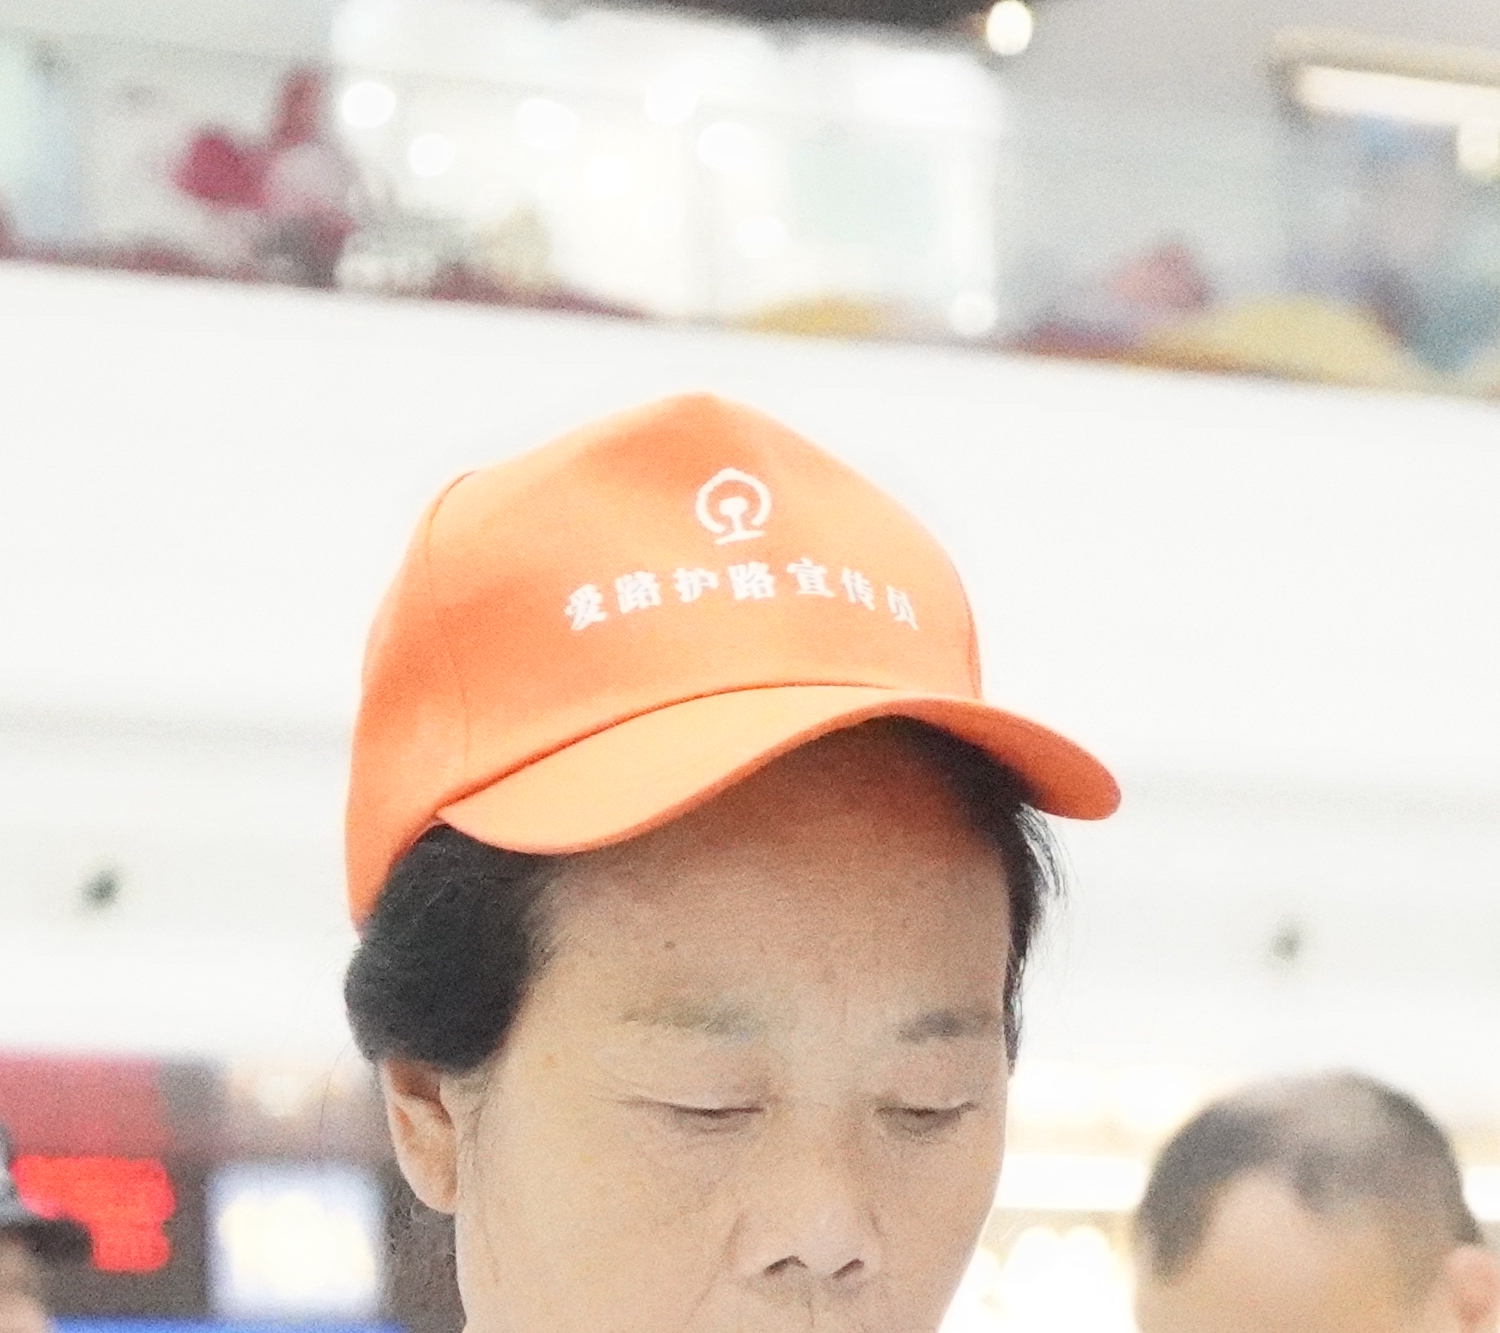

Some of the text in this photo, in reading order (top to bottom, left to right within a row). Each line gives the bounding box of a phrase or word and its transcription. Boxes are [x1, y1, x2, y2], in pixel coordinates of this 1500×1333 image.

[563, 556, 921, 632] 爱路护路宣传员
